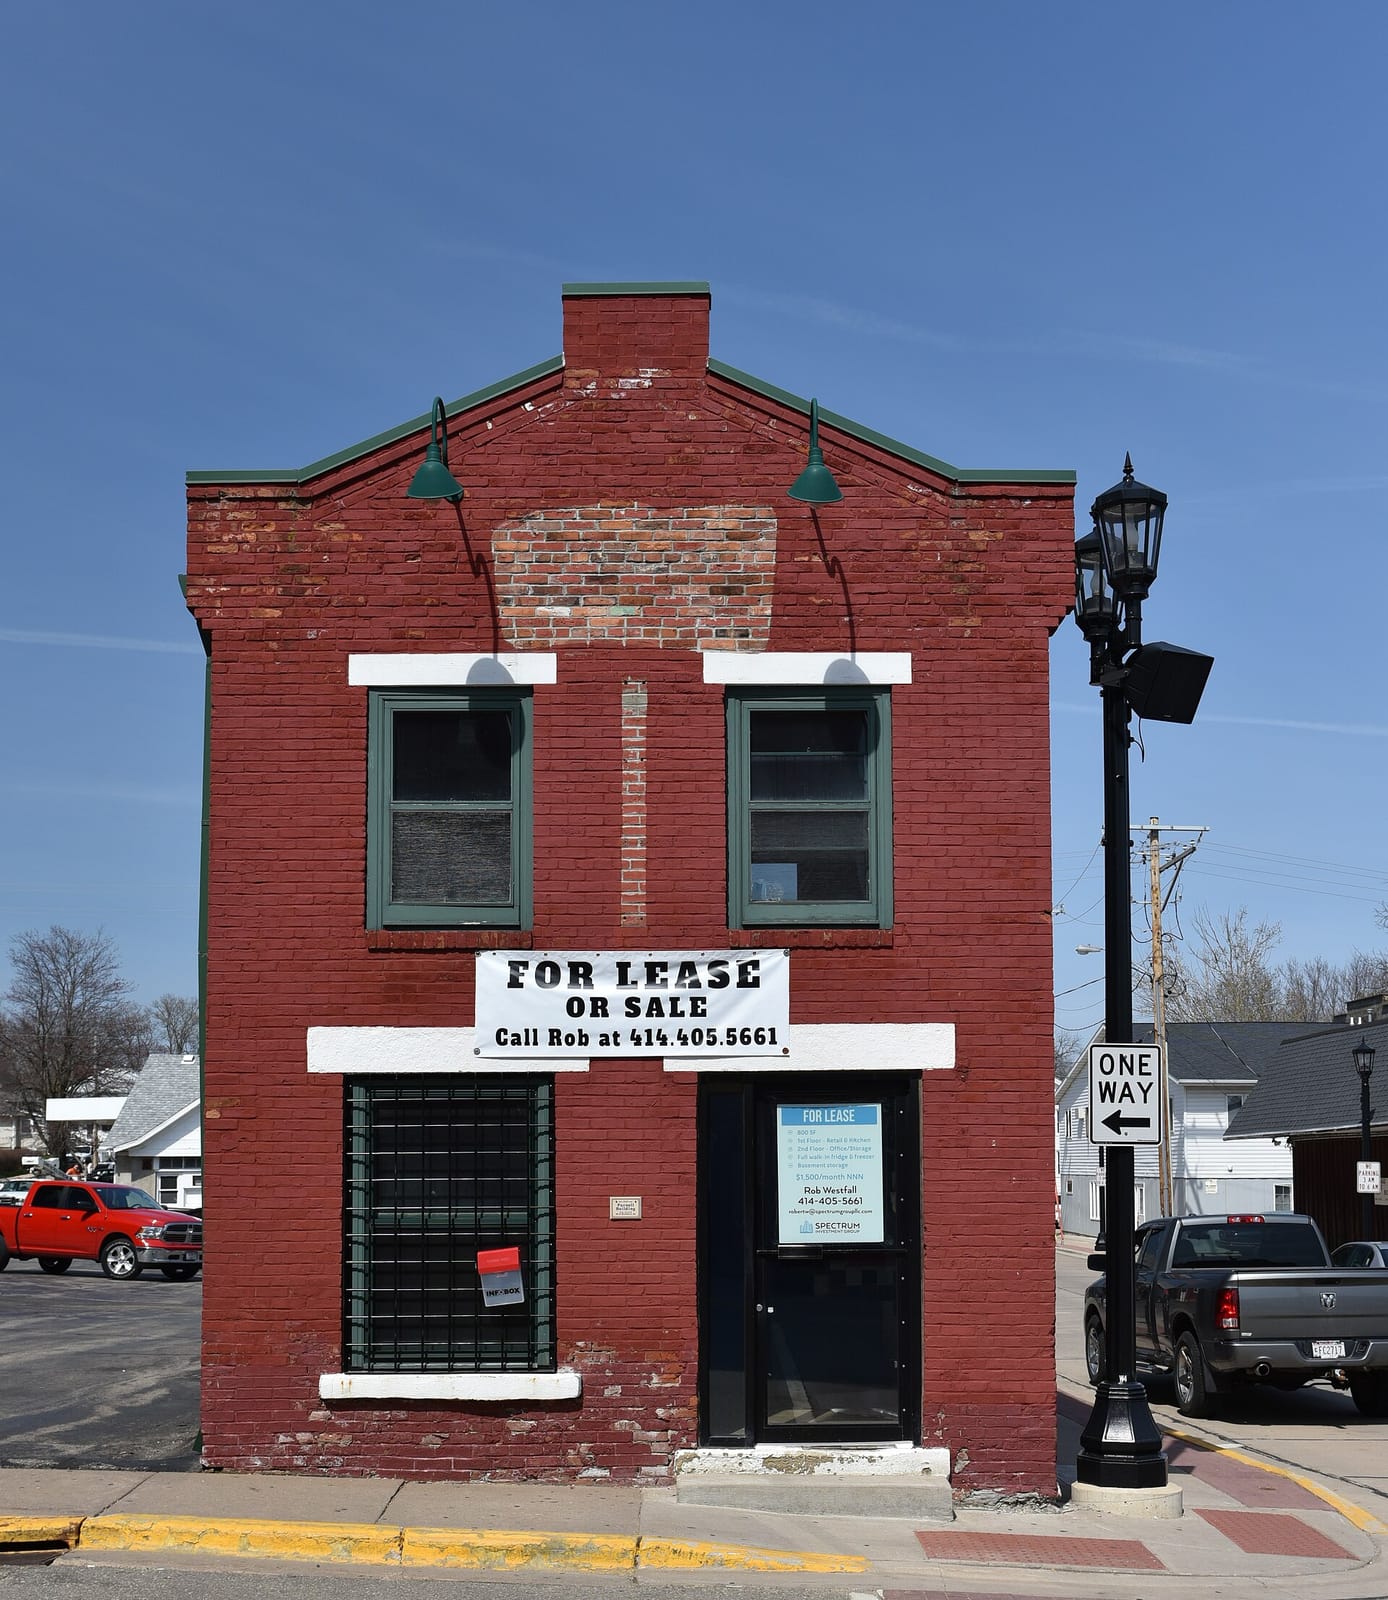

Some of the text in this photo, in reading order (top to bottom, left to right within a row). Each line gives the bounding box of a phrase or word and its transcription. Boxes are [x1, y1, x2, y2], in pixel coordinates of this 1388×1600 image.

[507, 960, 761, 989] FOR LEASE
[565, 996, 707, 1018] OR SALE
[495, 1027, 778, 1047] Call Rob at 414.405.5661
[1099, 1053, 1152, 1076] ONE
[1098, 1081, 1154, 1104] WAY
[803, 1109, 856, 1123] FOR LEASE
[826, 1162, 849, 1170] storage
[804, 1185, 857, 1195] Rob Westfall
[798, 1197, 863, 1206] 414-405-5661
[815, 1222, 861, 1230] SPECTRUM
